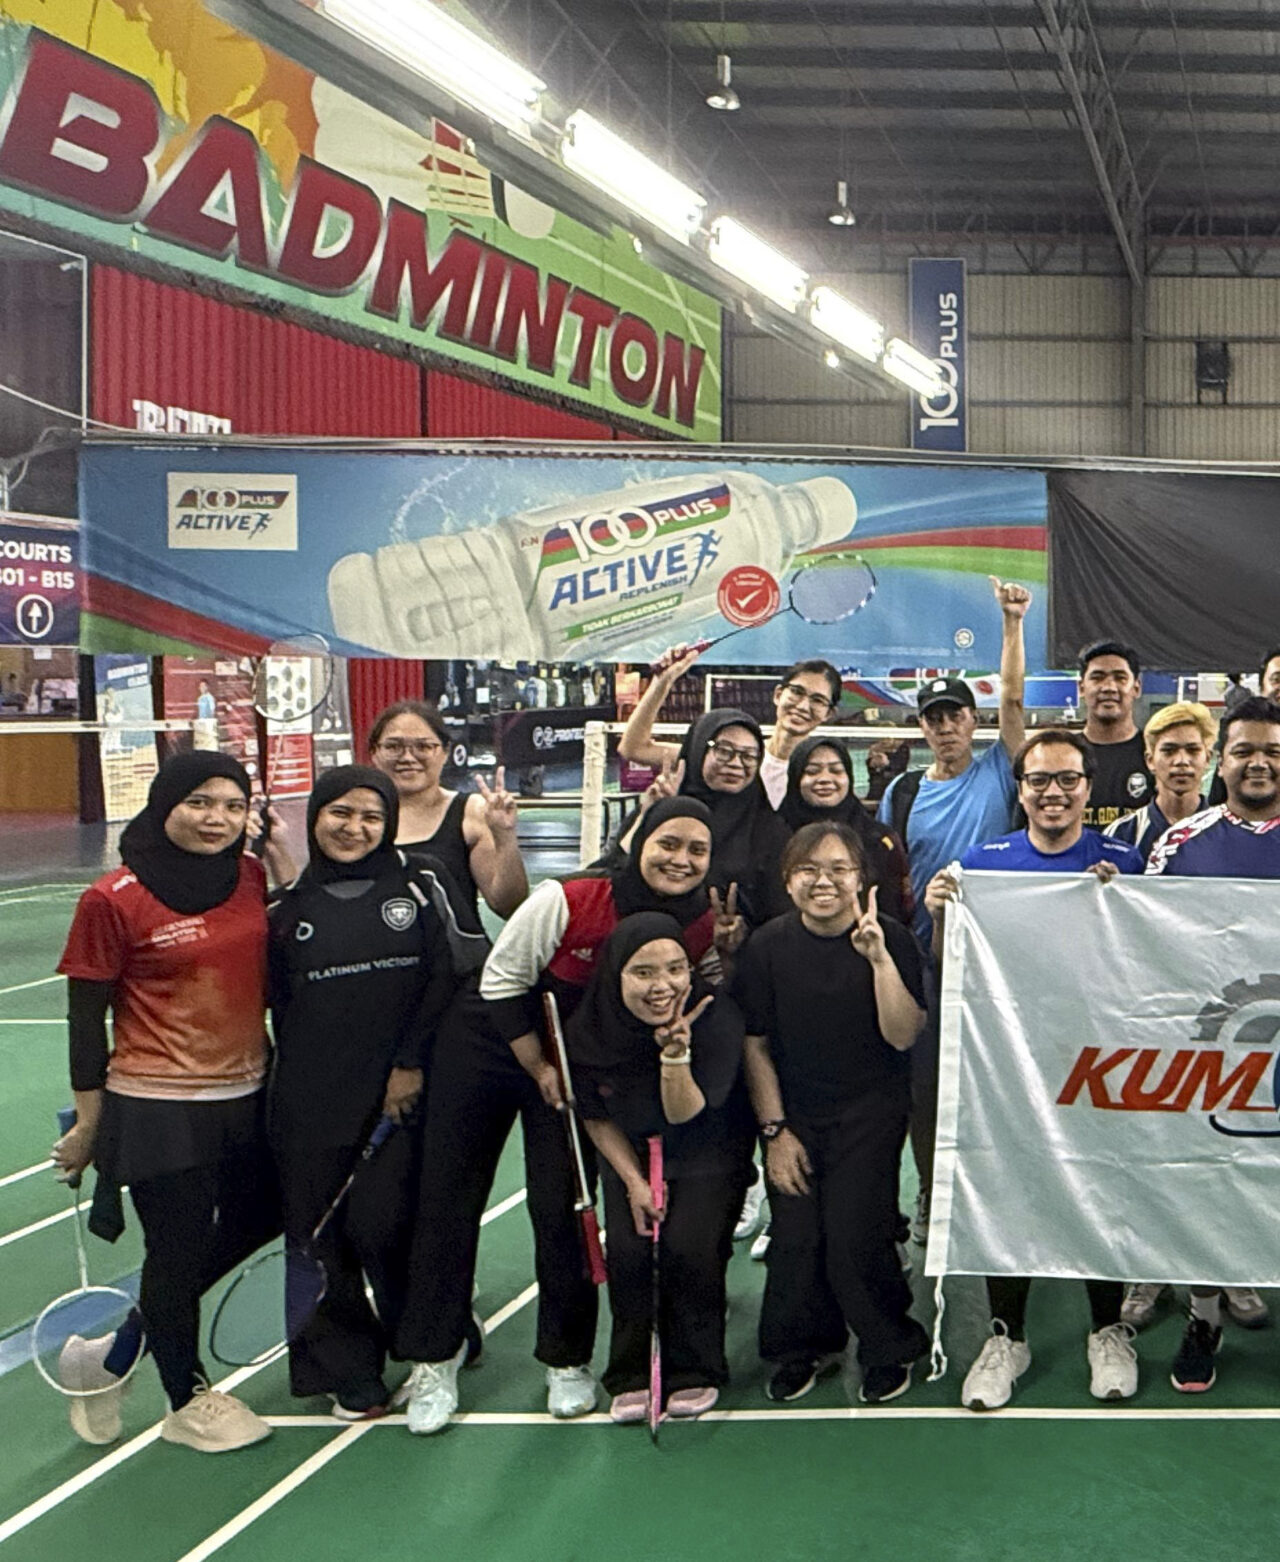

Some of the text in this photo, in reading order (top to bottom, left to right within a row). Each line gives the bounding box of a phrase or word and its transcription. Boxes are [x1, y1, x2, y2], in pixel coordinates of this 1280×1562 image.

[0, 29, 706, 428] BADMINTON
[176, 513, 251, 531] ACTIVE
[0, 567, 25, 587] 01
[41, 570, 75, 589] B15
[548, 543, 689, 611] ACTIVE
[308, 962, 371, 981] PLATINUM
[1056, 1046, 1278, 1113] KUM
